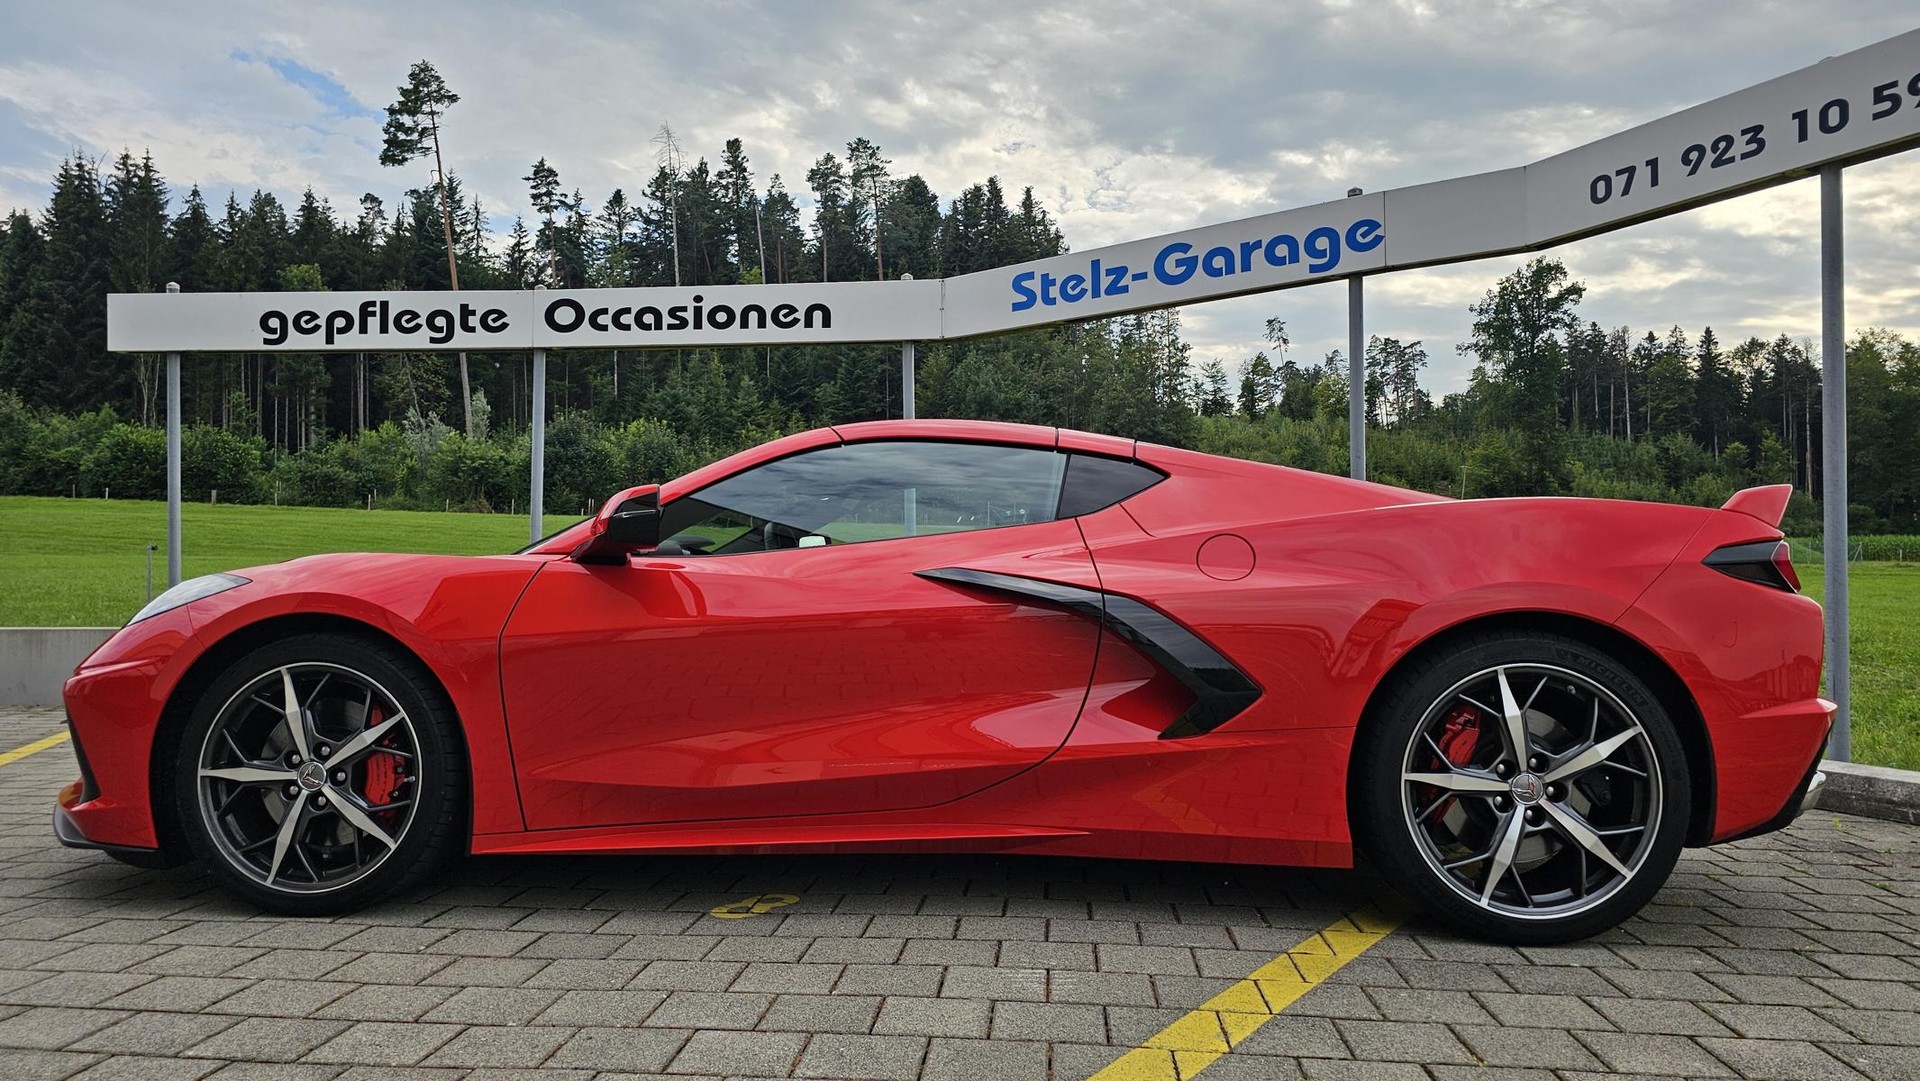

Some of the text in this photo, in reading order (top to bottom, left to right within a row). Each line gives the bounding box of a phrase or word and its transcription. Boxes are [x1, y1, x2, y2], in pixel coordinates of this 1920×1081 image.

[1589, 156, 1659, 205] 071
[1680, 124, 1766, 178] 923
[1791, 98, 1850, 144] 10
[1011, 218, 1385, 312] Stelz-Garage
[259, 294, 832, 346] gepflegte Occasionen
